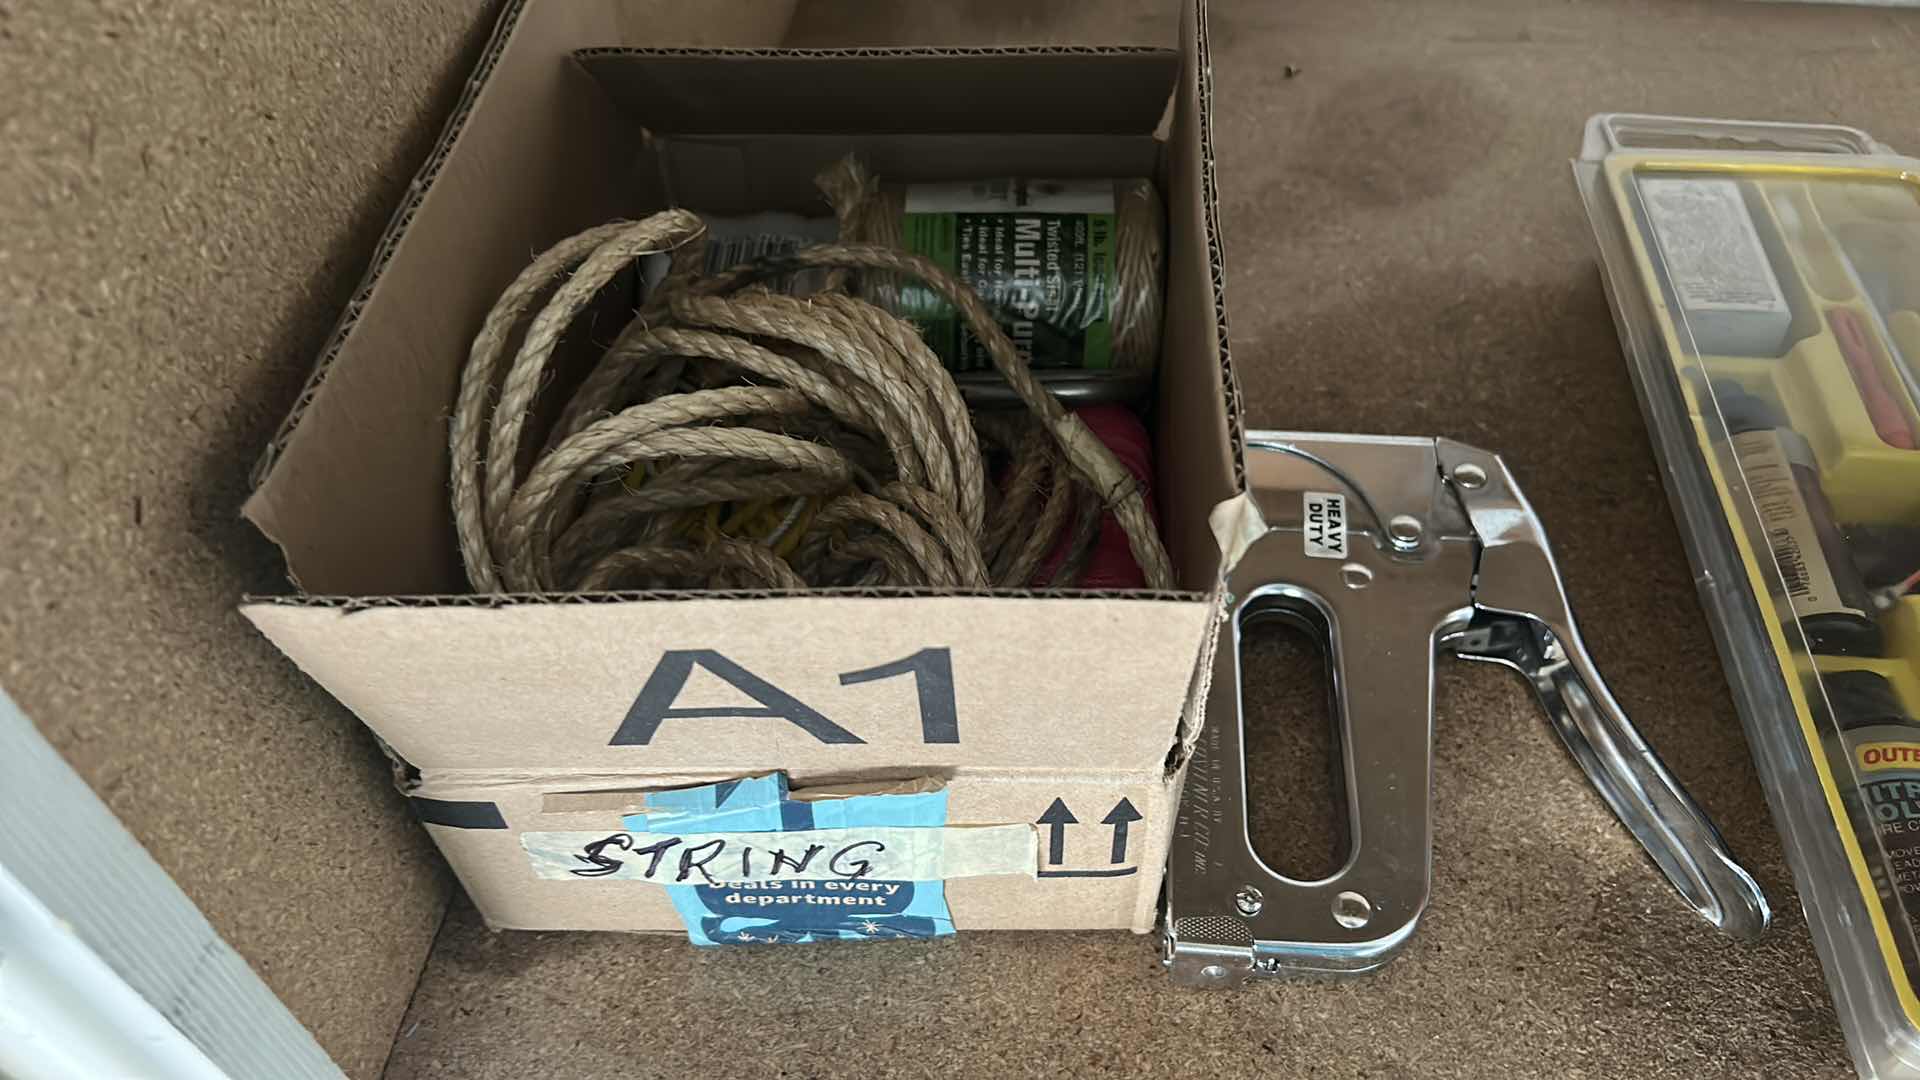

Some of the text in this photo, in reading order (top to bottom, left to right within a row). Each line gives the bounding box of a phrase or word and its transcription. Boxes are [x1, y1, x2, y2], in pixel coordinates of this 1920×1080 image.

[1046, 219, 1061, 271] Twisted
[1309, 503, 1324, 546] DUTY
[1327, 499, 1342, 553] HEAVY
[608, 647, 960, 746] A1
[569, 833, 886, 885] STRING
[725, 891, 887, 907] department
[791, 879, 816, 890] in
[824, 880, 901, 896] every
